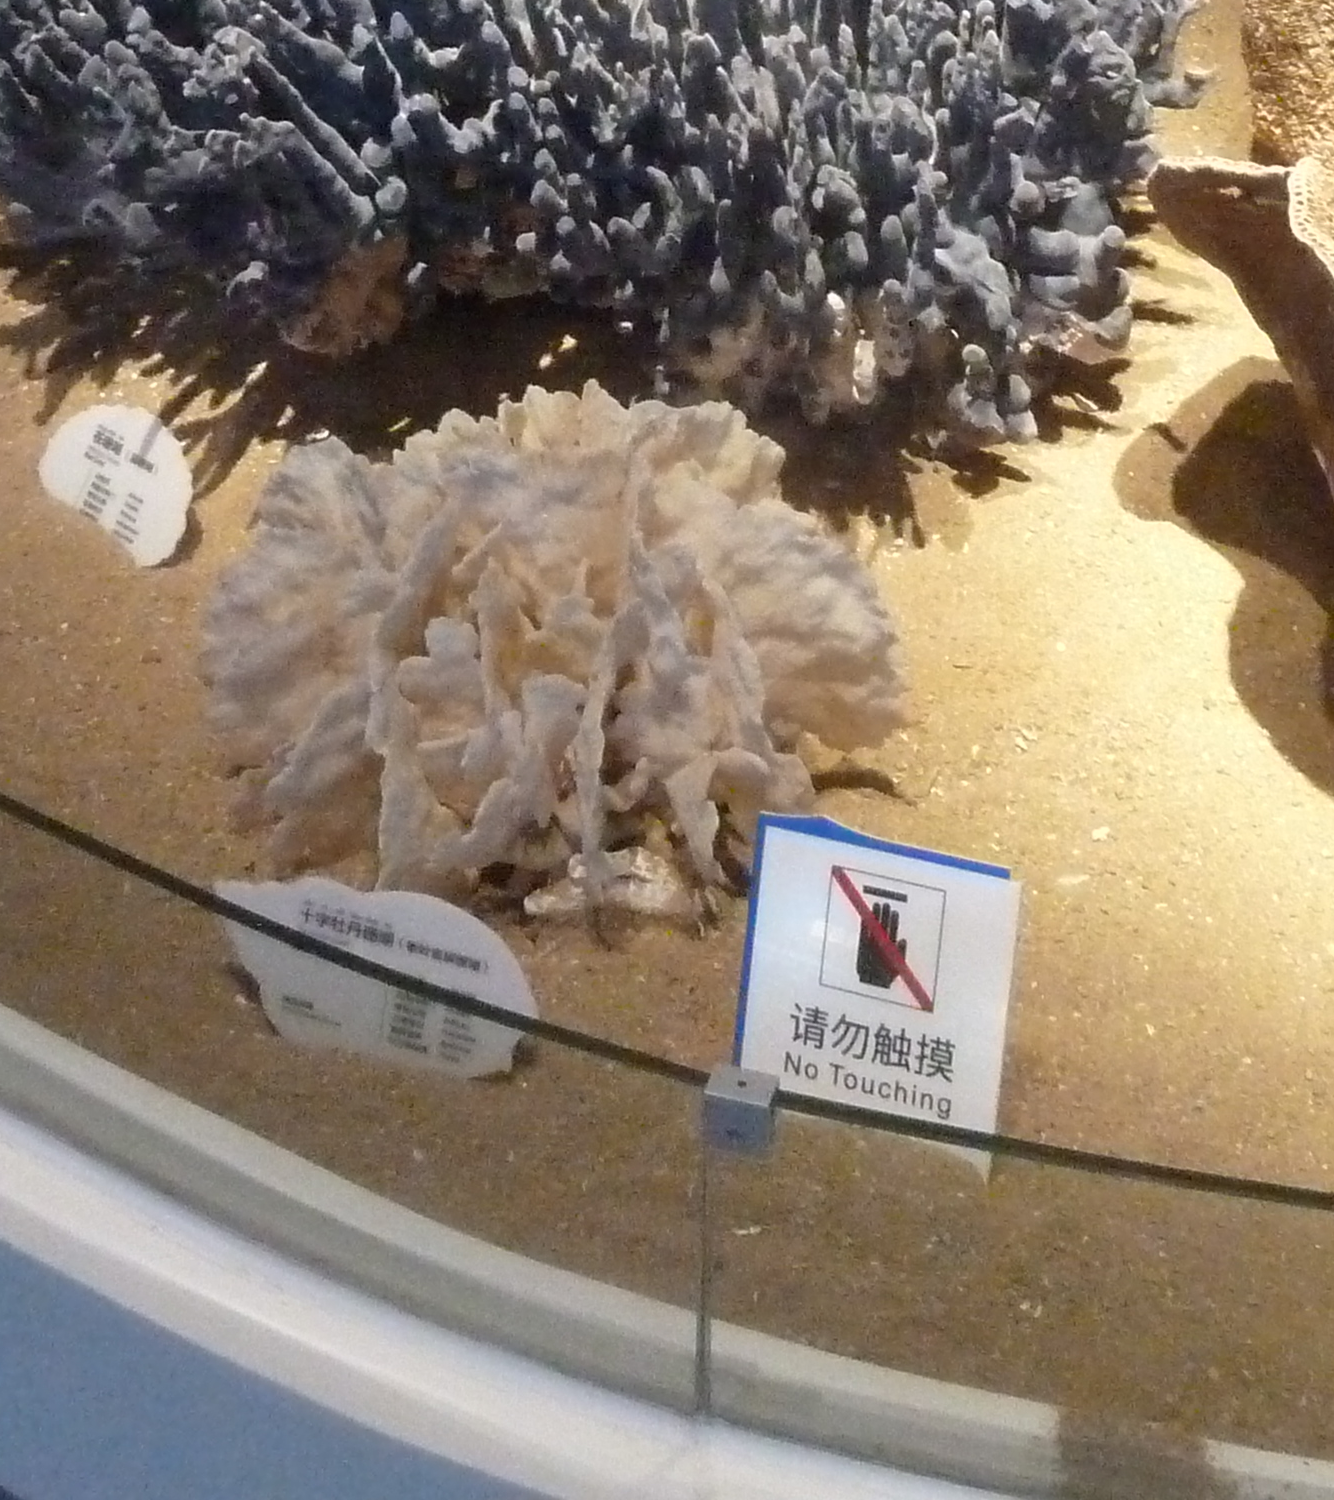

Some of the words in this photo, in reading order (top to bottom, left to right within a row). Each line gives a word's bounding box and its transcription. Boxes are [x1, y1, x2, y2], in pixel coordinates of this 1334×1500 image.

[790, 1003, 956, 1083] 请勿触摸
[784, 1051, 819, 1080] No
[829, 1062, 953, 1119] Touching
